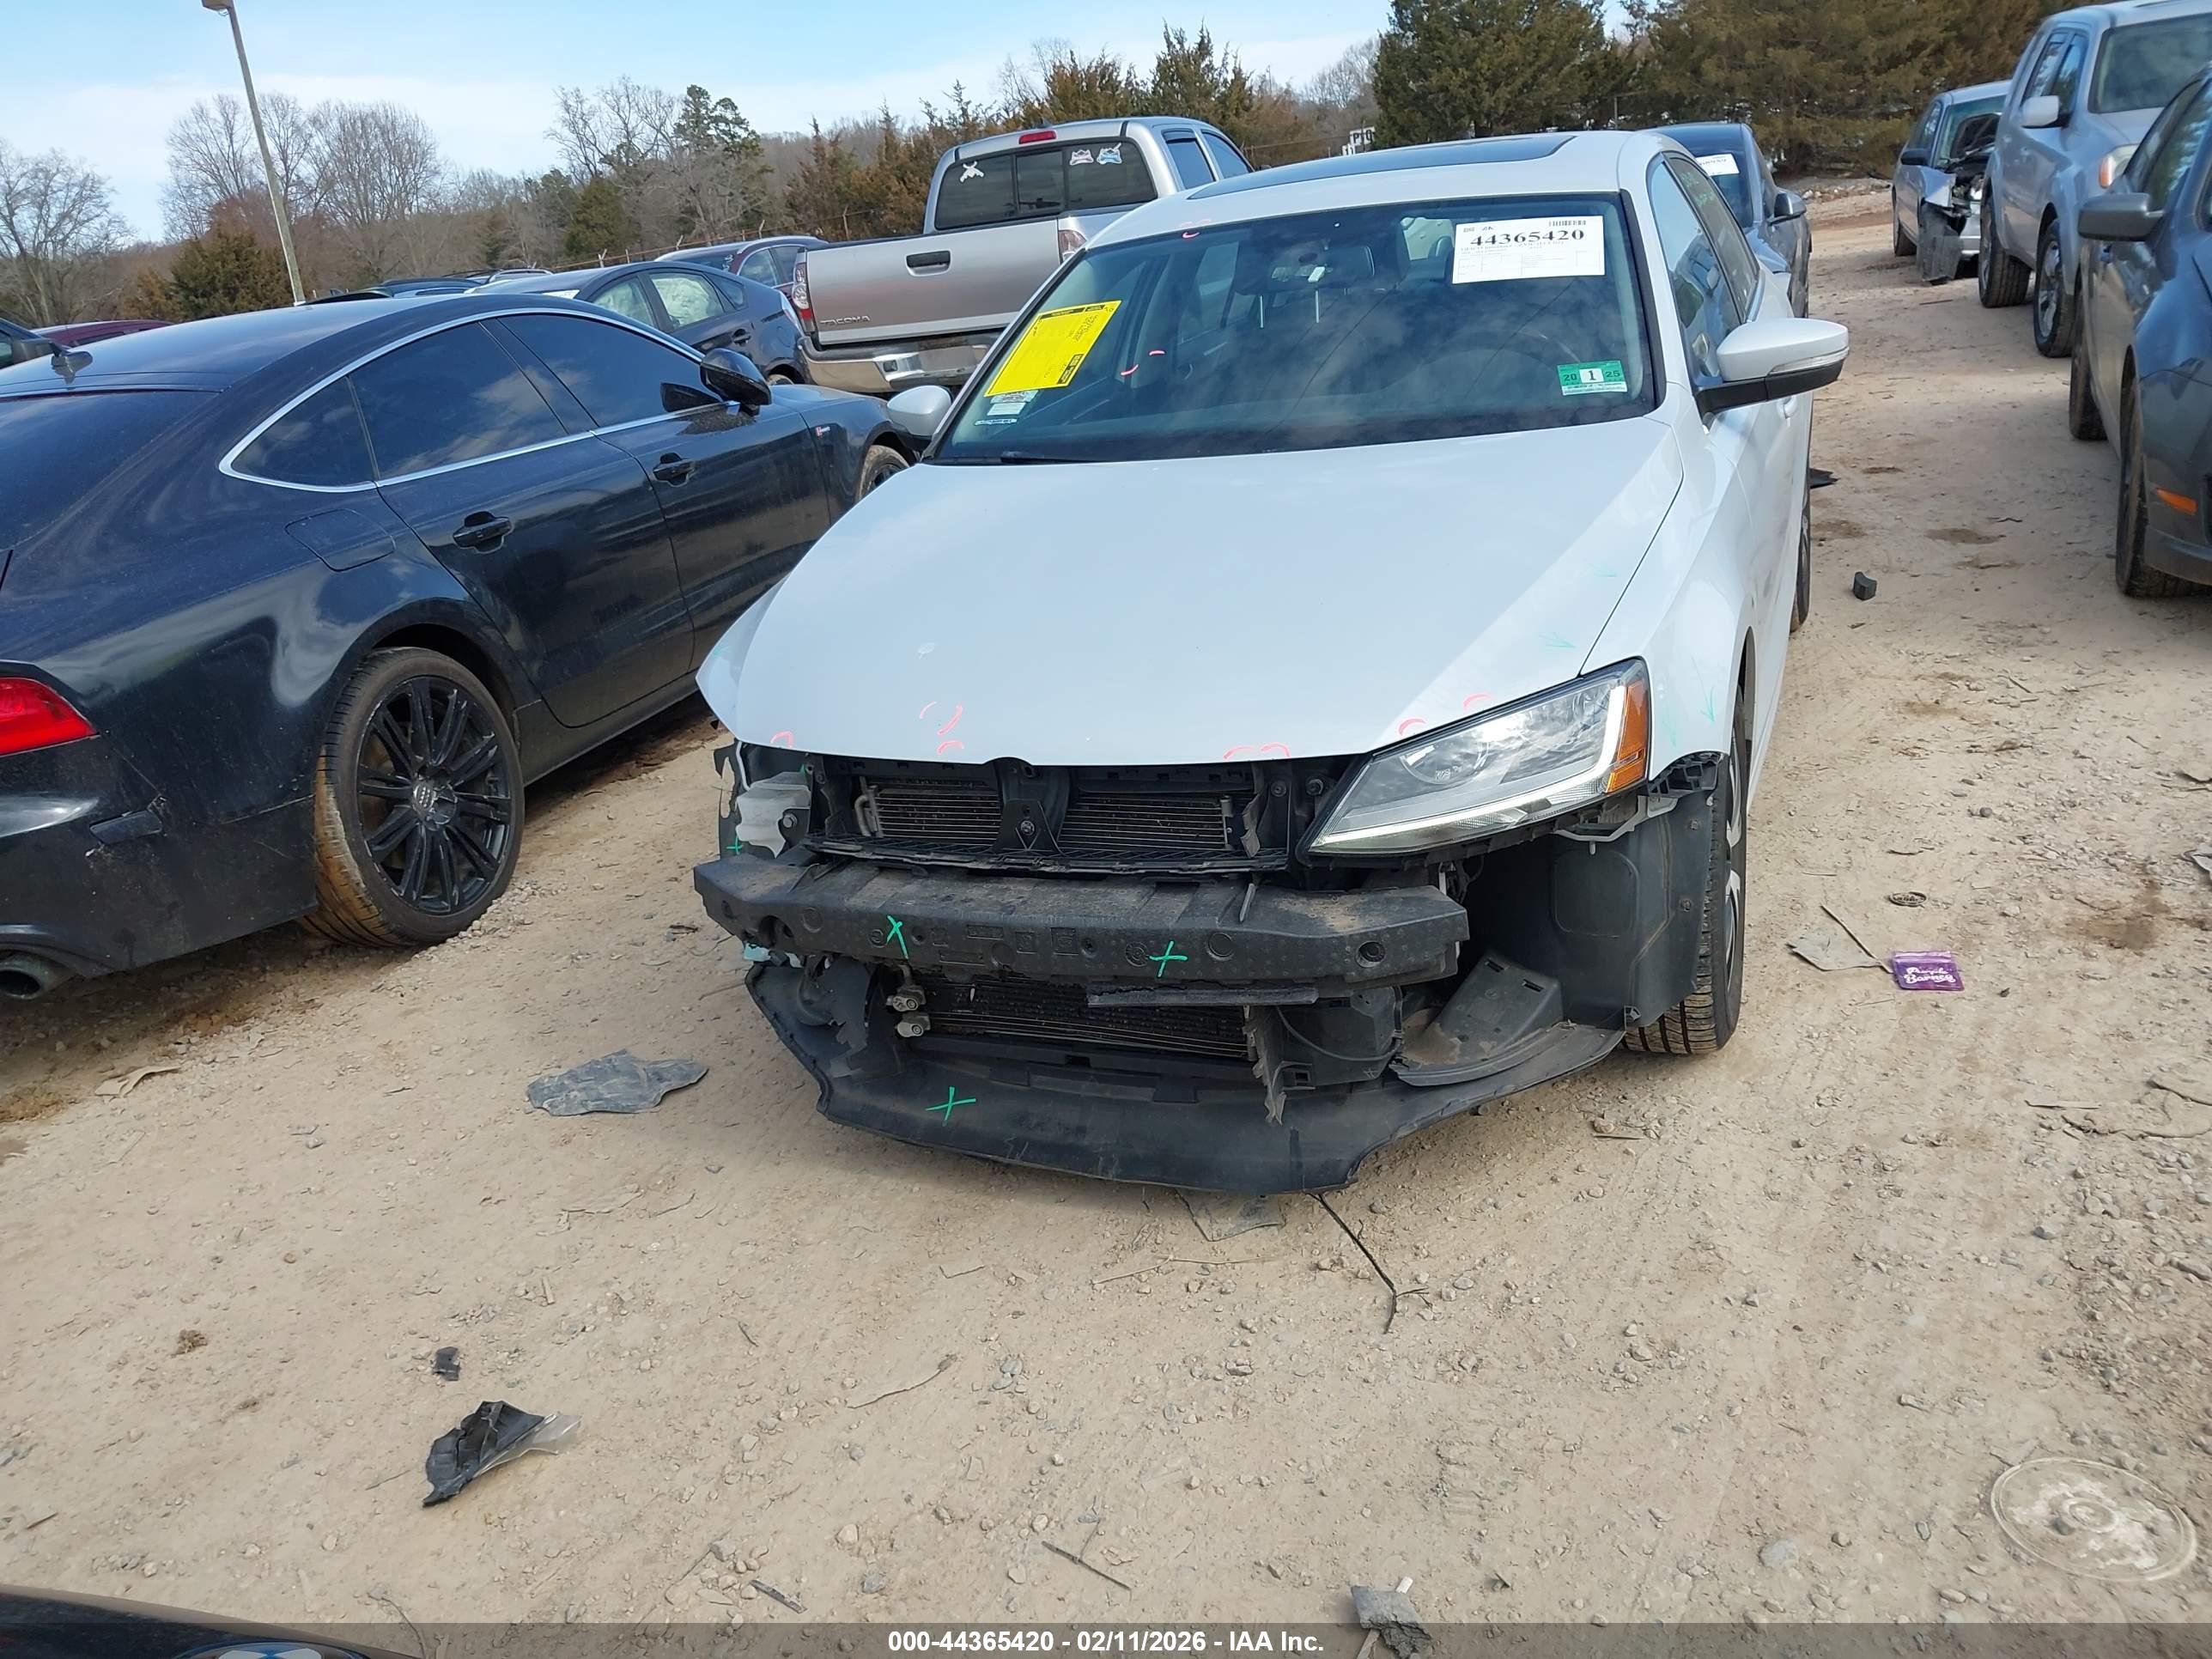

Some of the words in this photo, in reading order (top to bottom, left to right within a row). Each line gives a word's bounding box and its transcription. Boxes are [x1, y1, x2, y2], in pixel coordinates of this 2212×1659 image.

[1469, 229, 1585, 246] 44365420
[819, 315, 871, 325] TACOMA
[1562, 373, 1577, 382] 20
[1587, 369, 1597, 381] 1
[1605, 370, 1621, 379] 25
